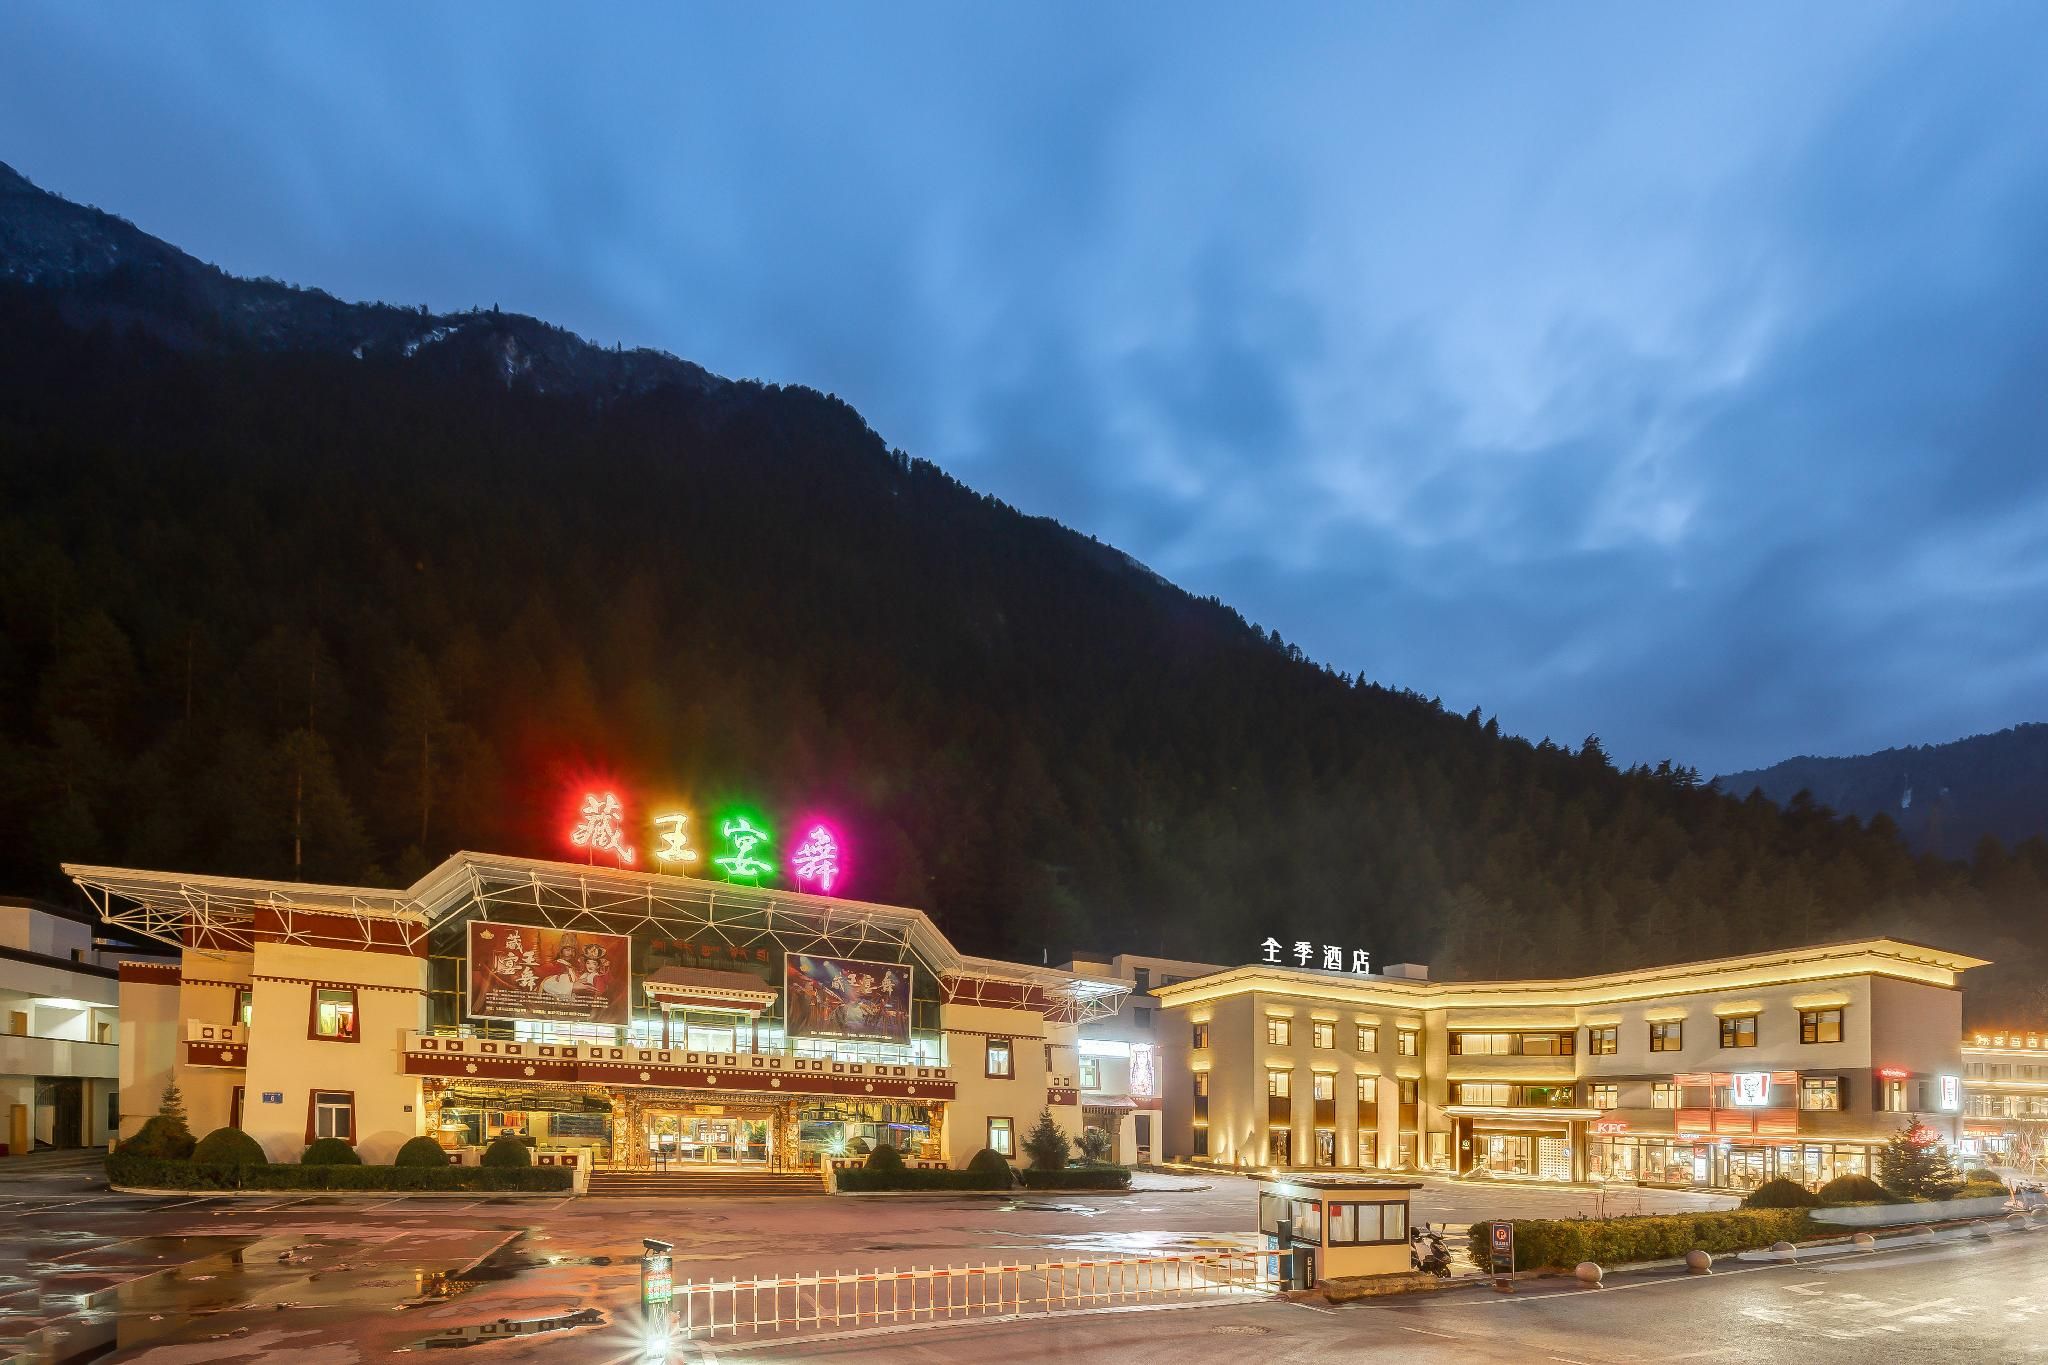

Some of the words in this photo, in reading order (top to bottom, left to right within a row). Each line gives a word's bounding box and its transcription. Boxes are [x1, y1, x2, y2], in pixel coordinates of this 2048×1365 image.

[571, 793, 838, 890] 藏王宴舞
[1260, 936, 1370, 975] 全季酒店
[1597, 1123, 1627, 1134] KFC
